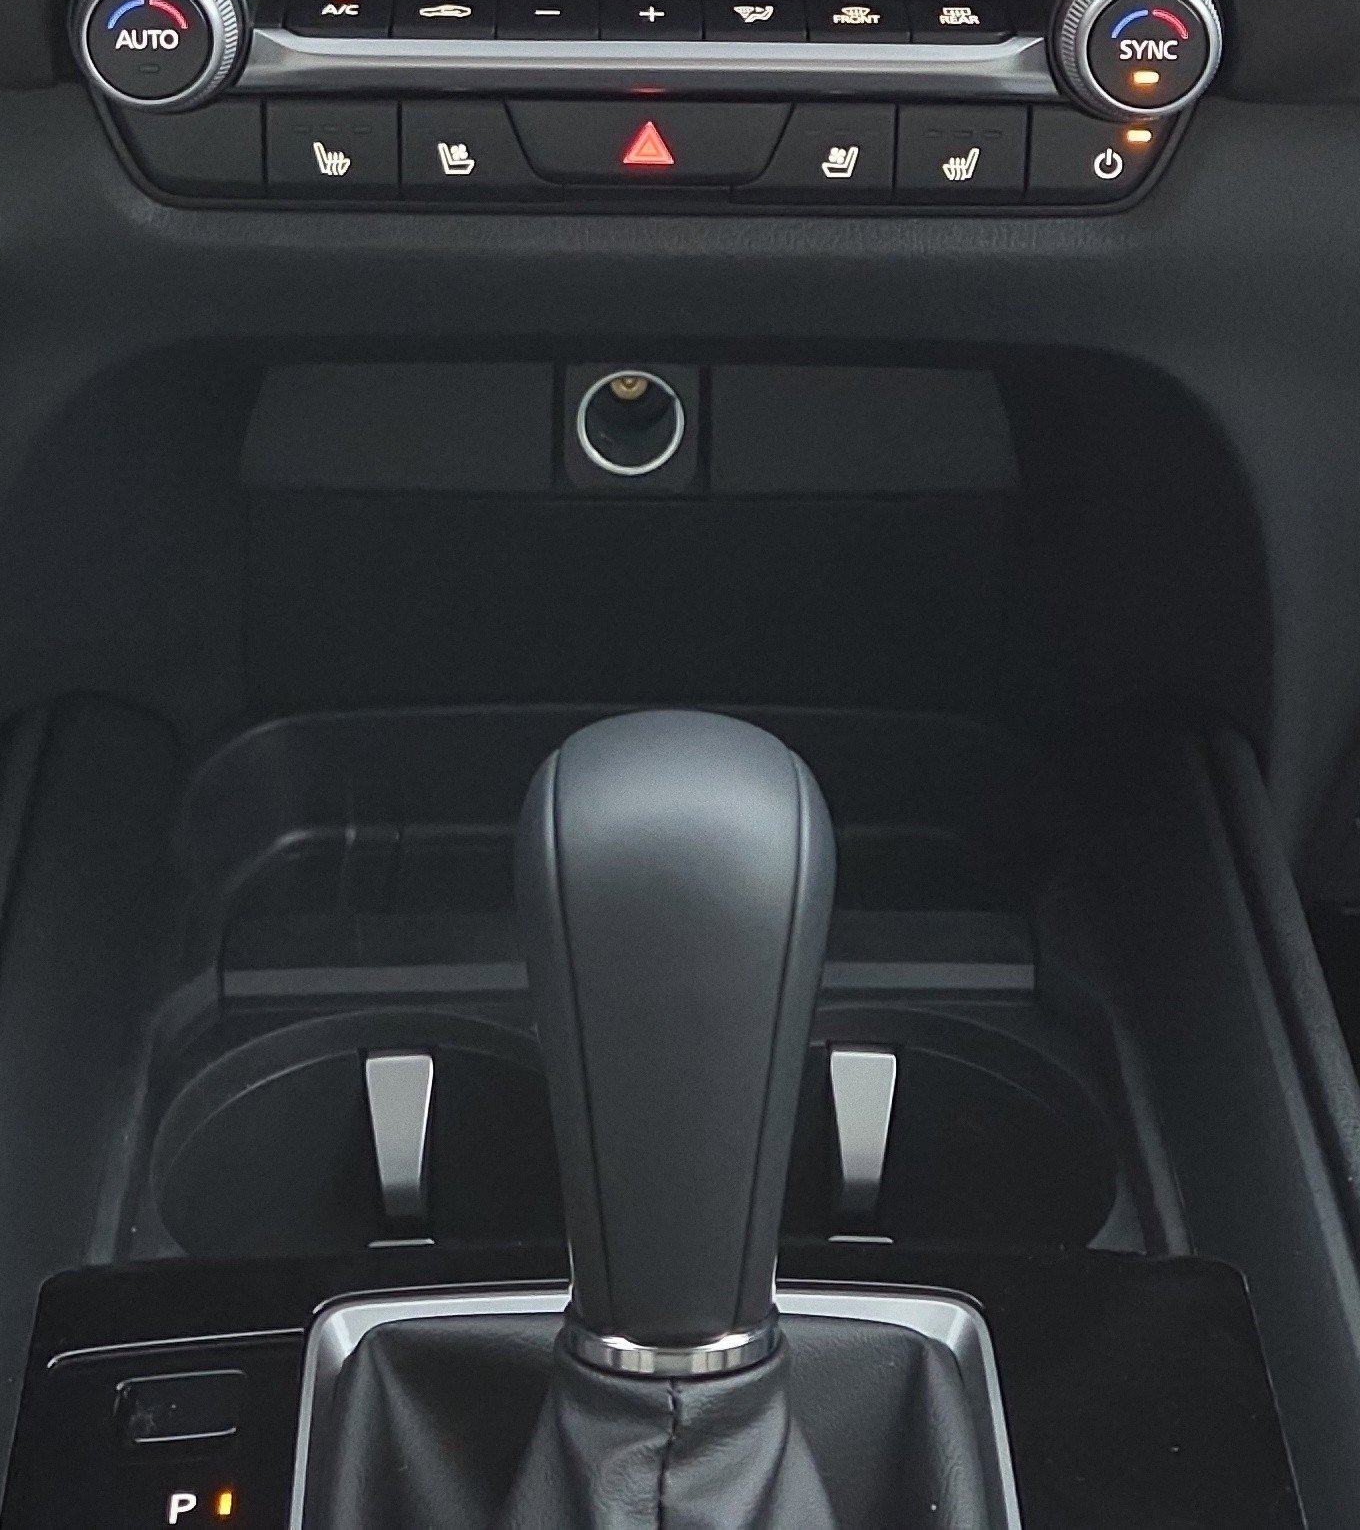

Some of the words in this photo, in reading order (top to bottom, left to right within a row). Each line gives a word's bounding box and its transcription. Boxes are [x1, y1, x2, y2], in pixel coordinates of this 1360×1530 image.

[321, 3, 360, 16] A/C
[833, 14, 881, 25] FRONT
[939, 15, 980, 25] REAR
[115, 28, 180, 51] AUTO
[1119, 39, 1179, 61] SYNC
[169, 1492, 197, 1525] P
